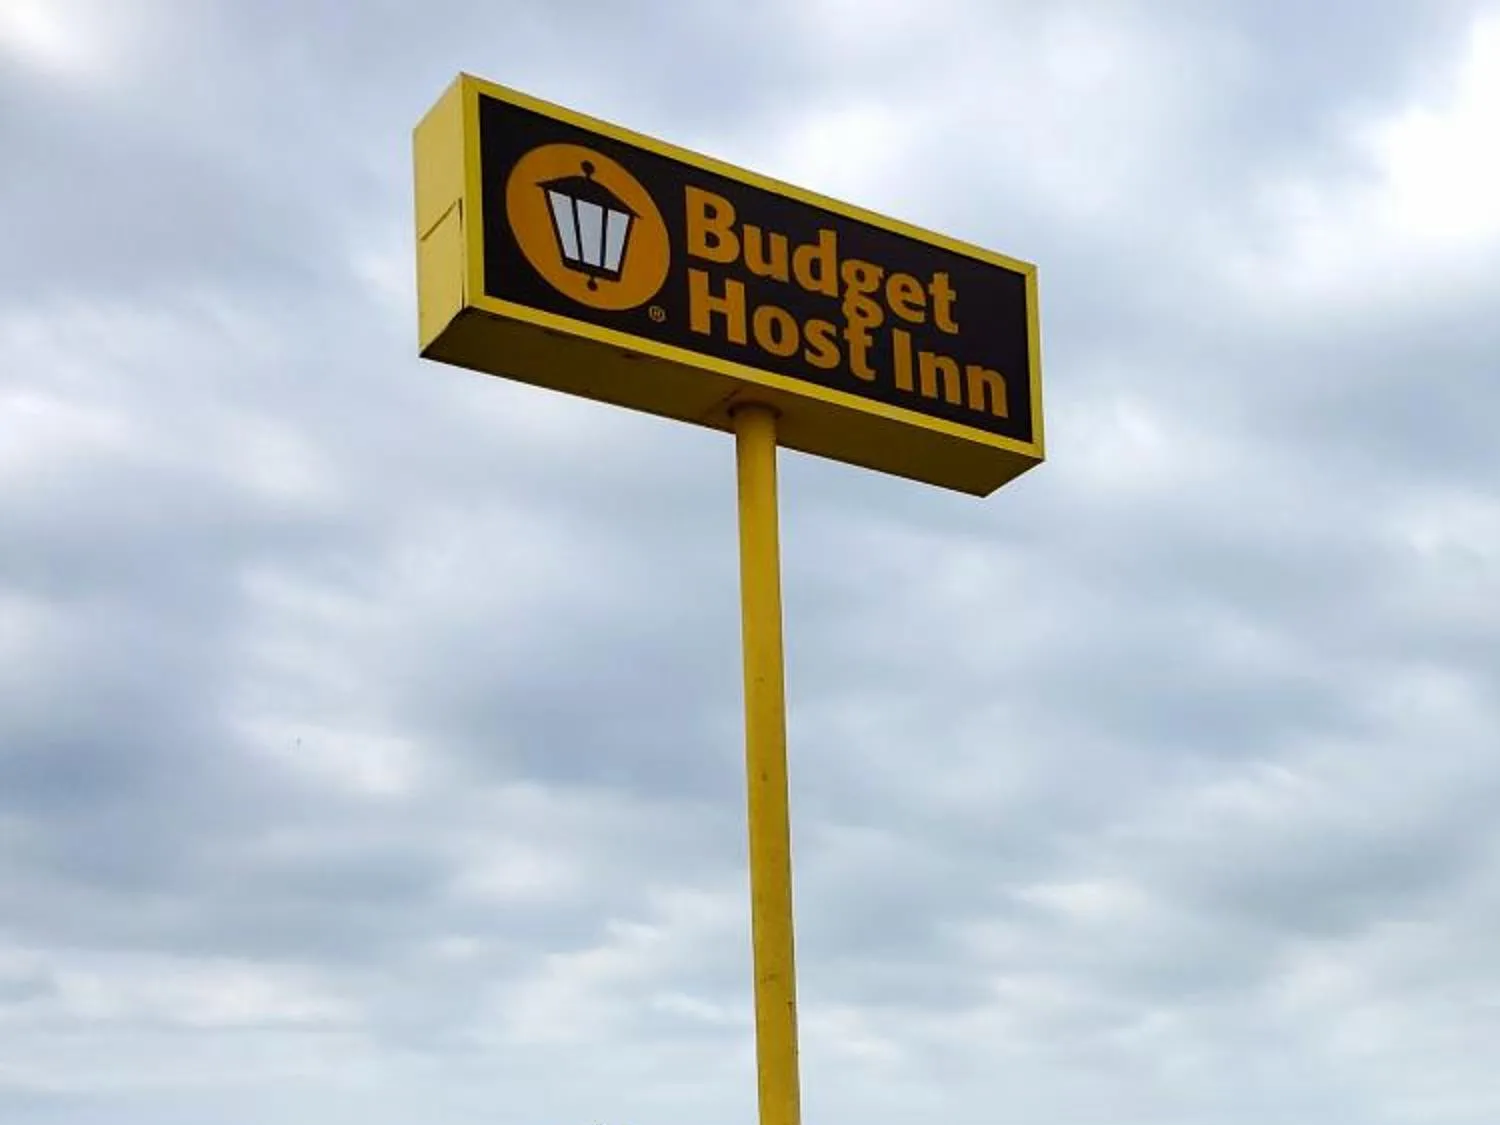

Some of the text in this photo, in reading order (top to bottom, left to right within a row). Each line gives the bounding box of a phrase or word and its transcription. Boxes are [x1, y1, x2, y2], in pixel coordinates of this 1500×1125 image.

[685, 185, 958, 333] Budget
[688, 270, 1008, 417] Host Inn
